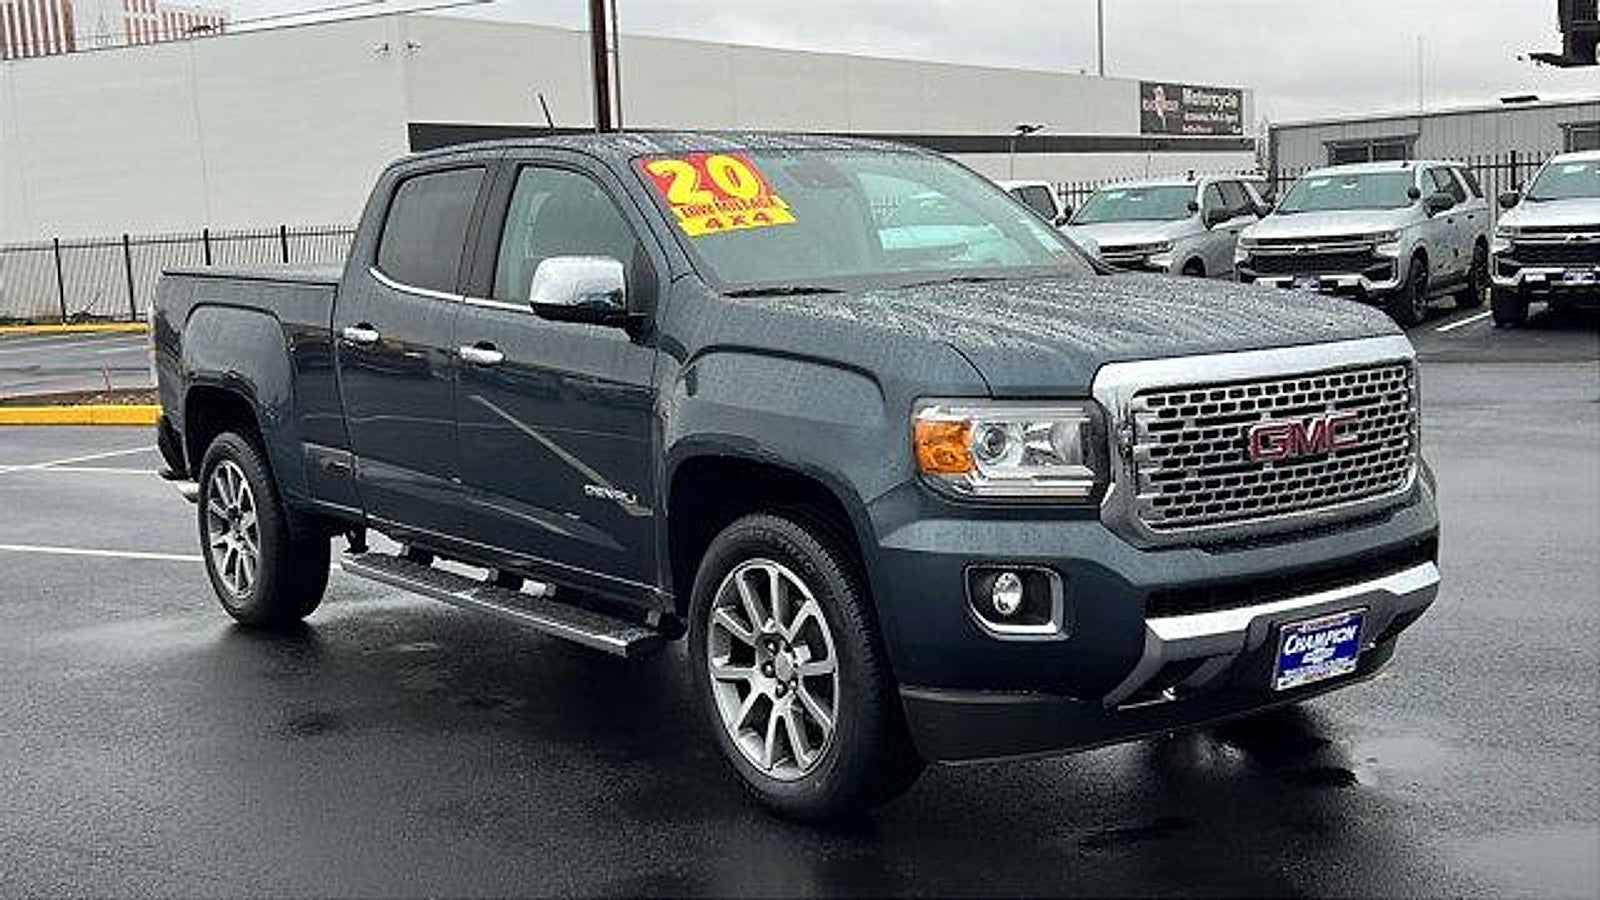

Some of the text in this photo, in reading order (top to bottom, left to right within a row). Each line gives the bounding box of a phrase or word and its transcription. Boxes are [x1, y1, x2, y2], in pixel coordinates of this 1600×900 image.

[1182, 87, 1239, 110] Motorcycle
[646, 154, 761, 204] 20
[1249, 409, 1358, 461] GMC
